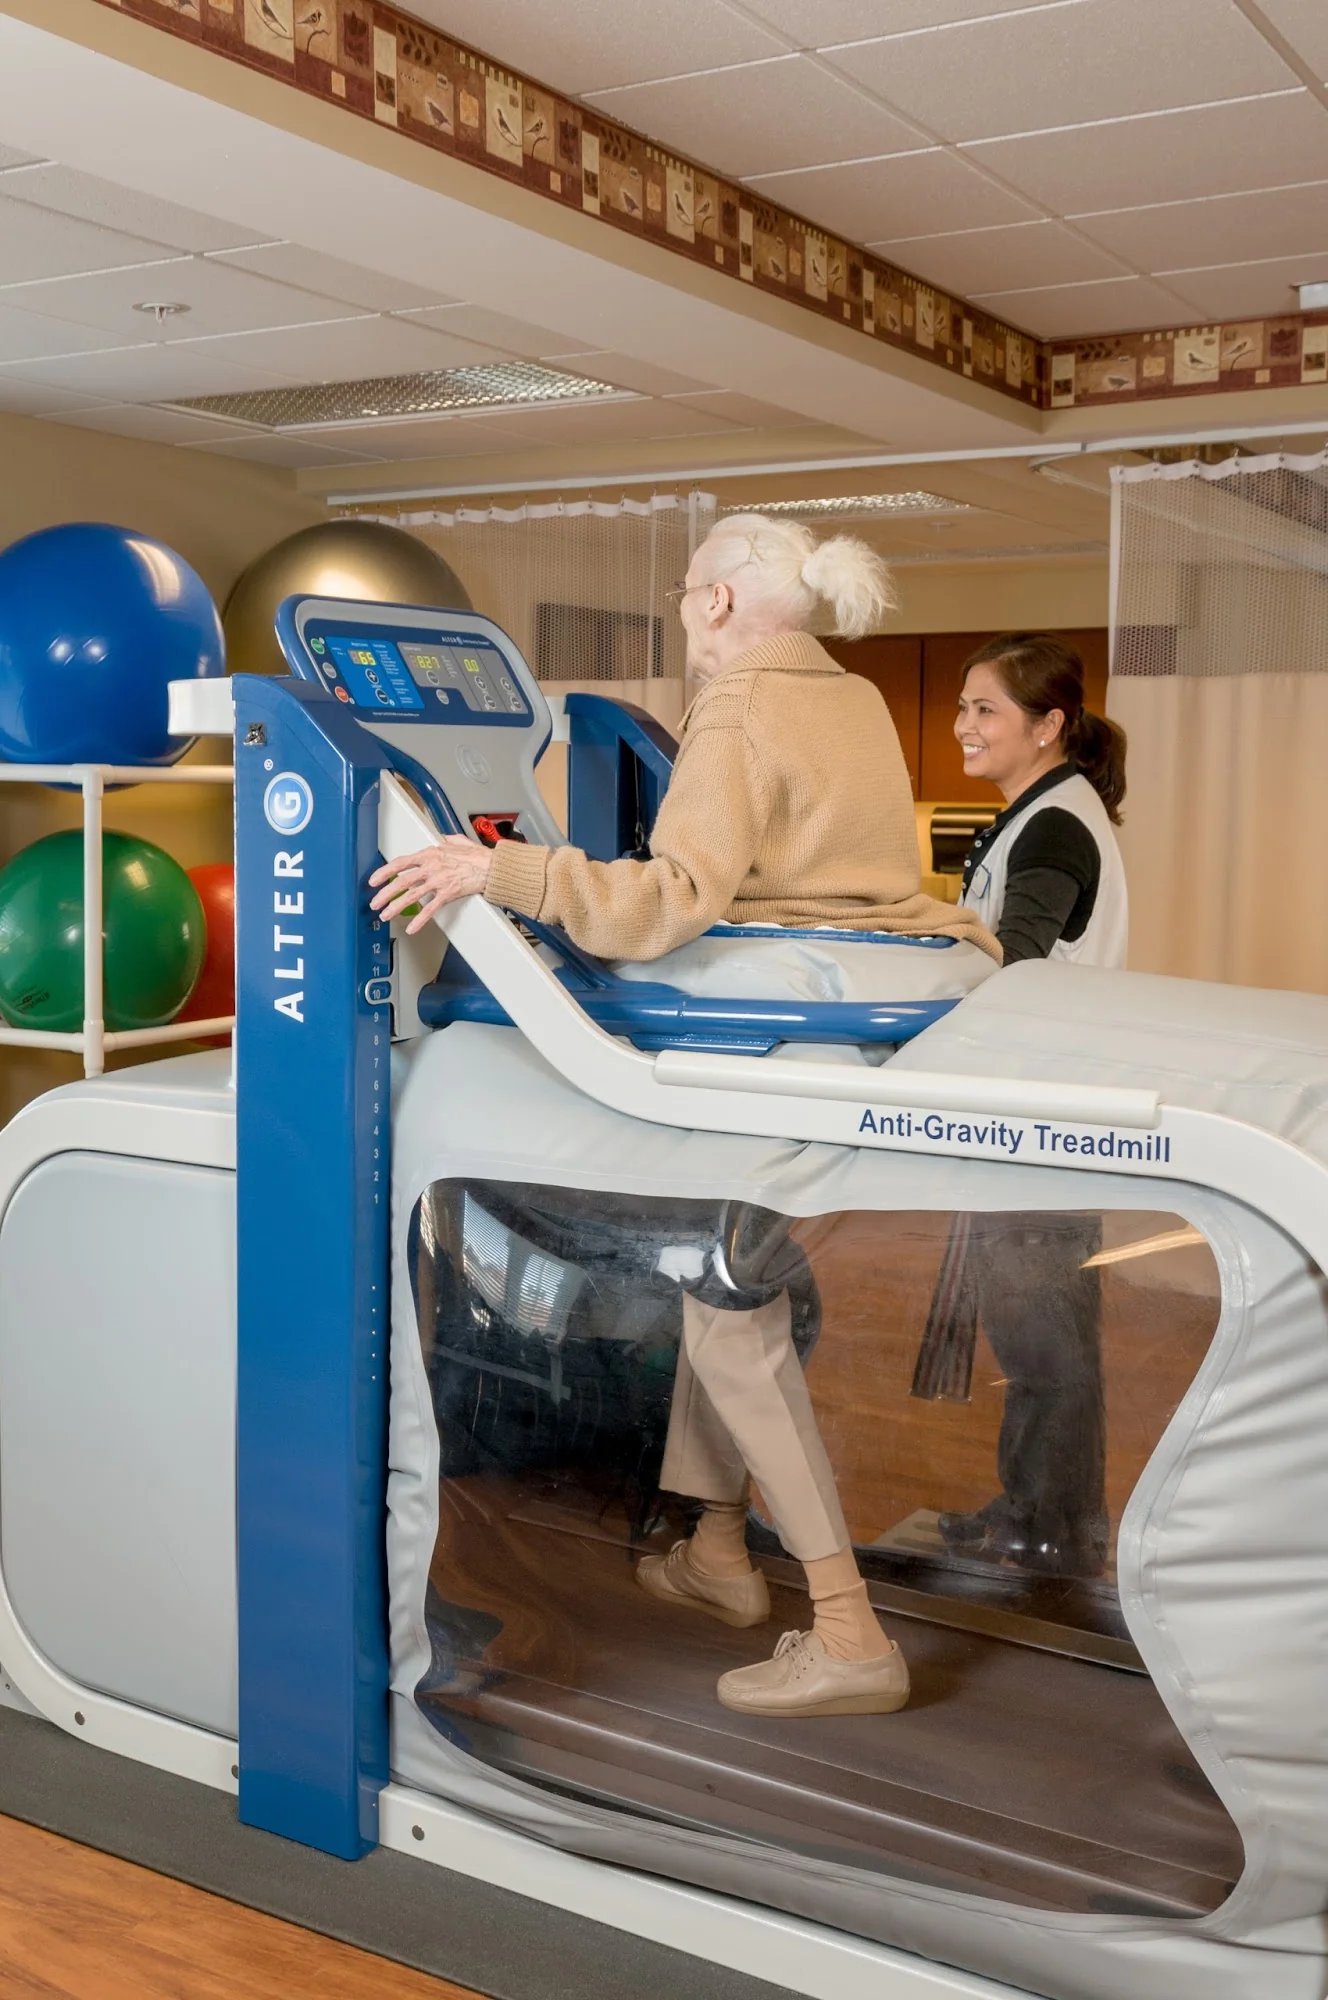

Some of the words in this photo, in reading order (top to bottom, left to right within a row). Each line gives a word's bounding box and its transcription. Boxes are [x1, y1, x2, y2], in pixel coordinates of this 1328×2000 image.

[372, 921, 381, 931] 13
[372, 943, 381, 954] 12
[372, 966, 380, 977] 11
[372, 988, 381, 999] 10
[373, 1012, 379, 1022] 9
[373, 1035, 379, 1045] 8
[373, 1058, 379, 1068] 7
[373, 1080, 379, 1091] 6
[373, 1103, 379, 1113] 5
[373, 1125, 379, 1136] 4
[858, 1108, 1024, 1154] Anti-Gravity
[1034, 1124, 1171, 1163] Treadmill
[373, 1148, 379, 1159] 3
[373, 1171, 379, 1181] 2
[374, 1193, 379, 1204] 1
